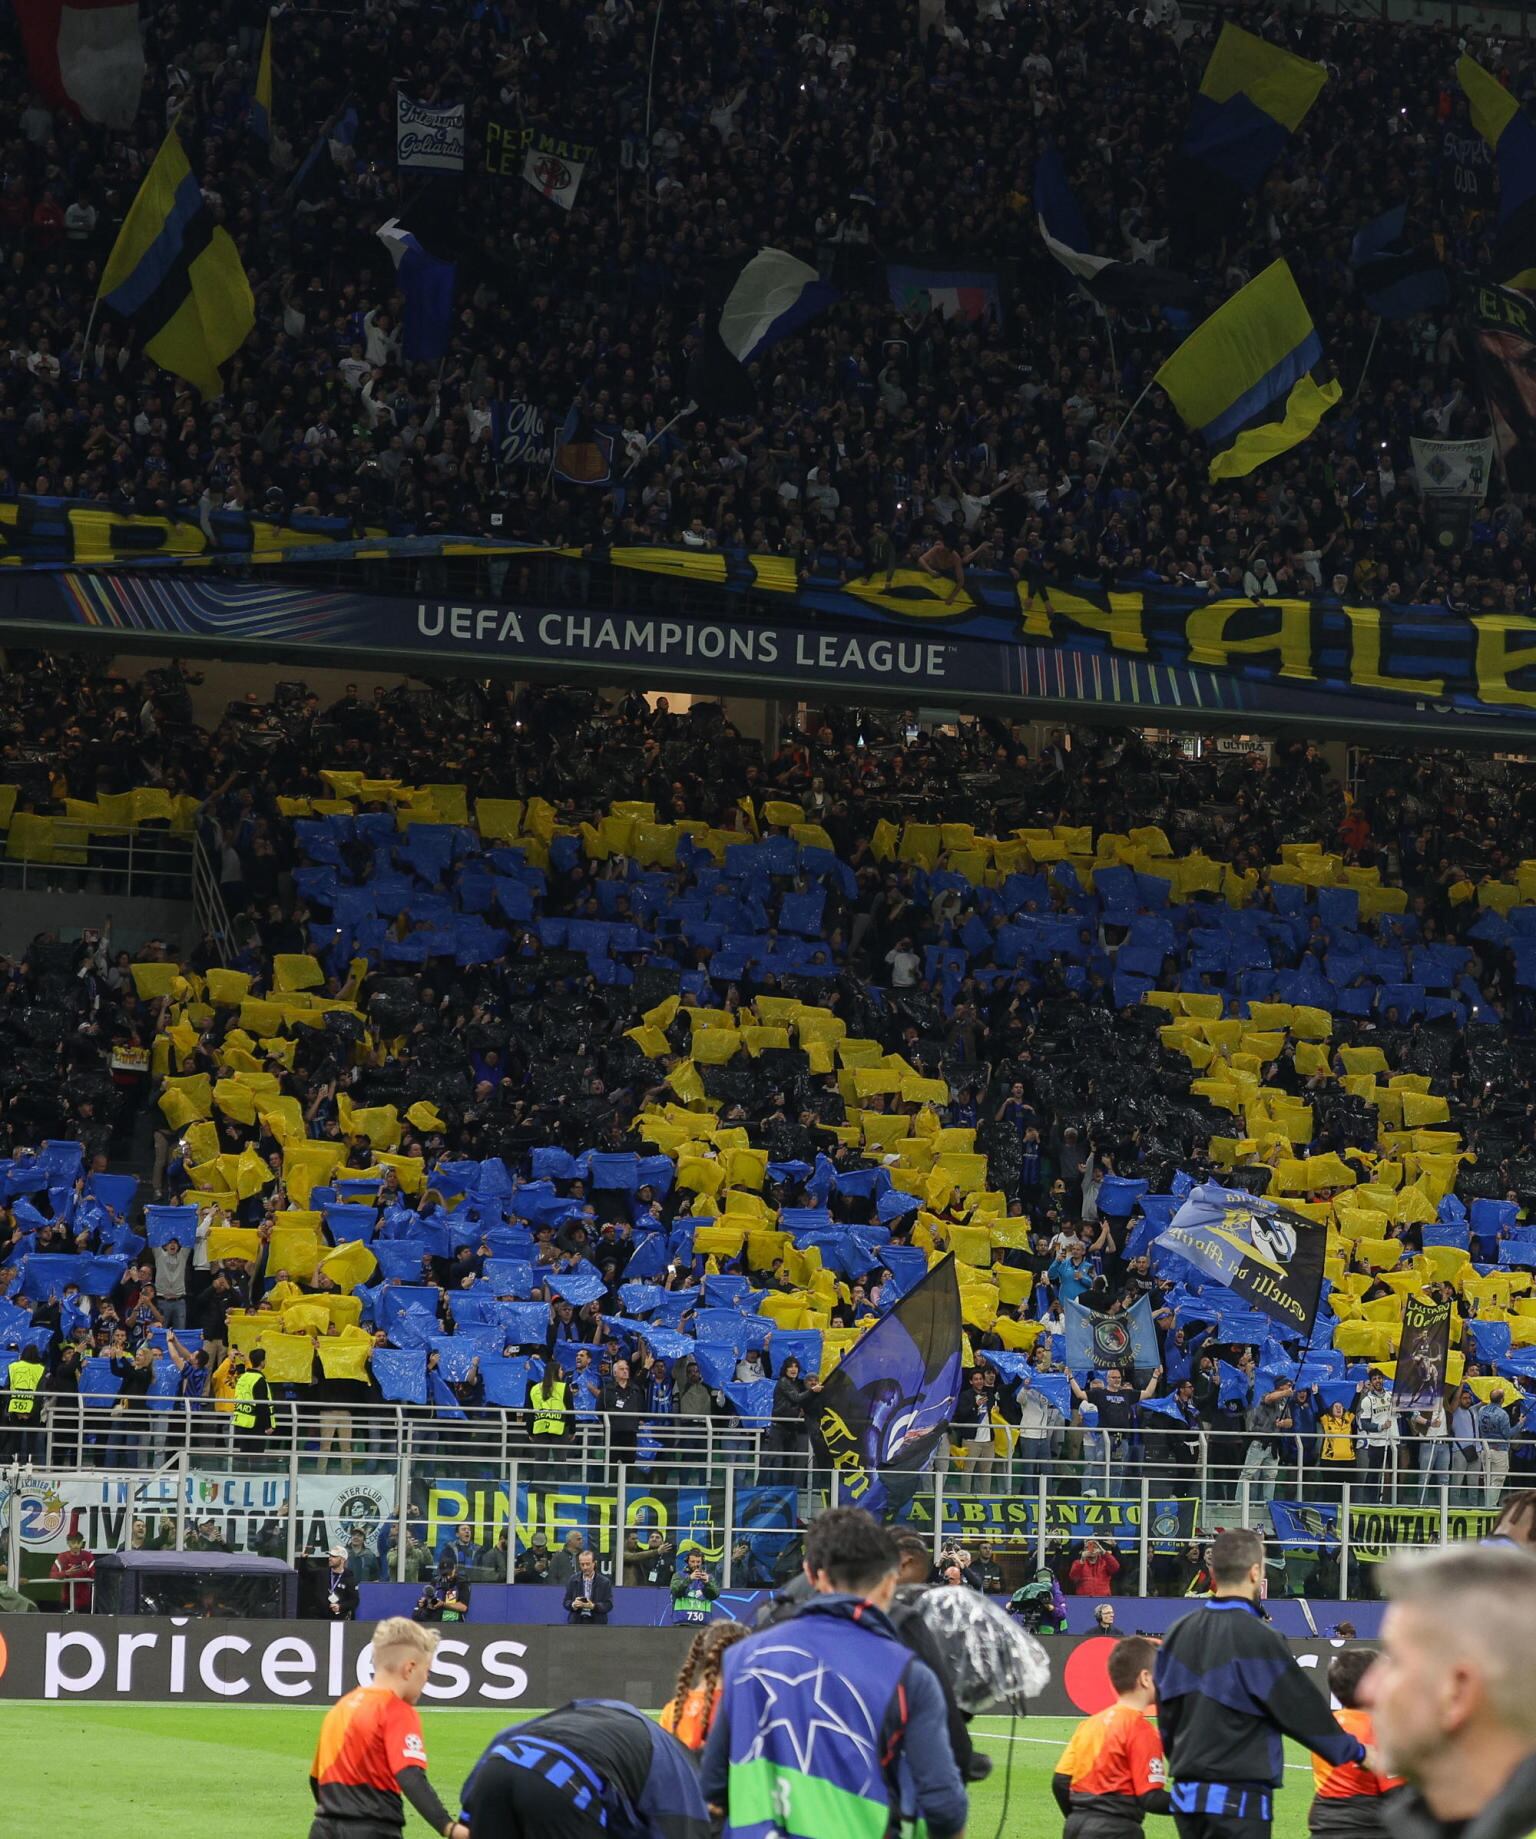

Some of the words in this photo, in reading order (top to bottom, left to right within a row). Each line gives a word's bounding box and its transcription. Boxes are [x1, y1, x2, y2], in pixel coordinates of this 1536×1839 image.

[486, 121, 535, 149] PER
[416, 604, 526, 643] UEFA
[537, 613, 779, 664] CHAMPIONS
[796, 633, 946, 677] LEAGUE
[12, 1401, 28, 1410] 362
[338, 1487, 361, 1504] INTER
[362, 1487, 383, 1503] CLUB
[427, 1488, 668, 1554] PINETO
[906, 1501, 1142, 1525] ALBISENZIO
[687, 1611, 704, 1622] 730
